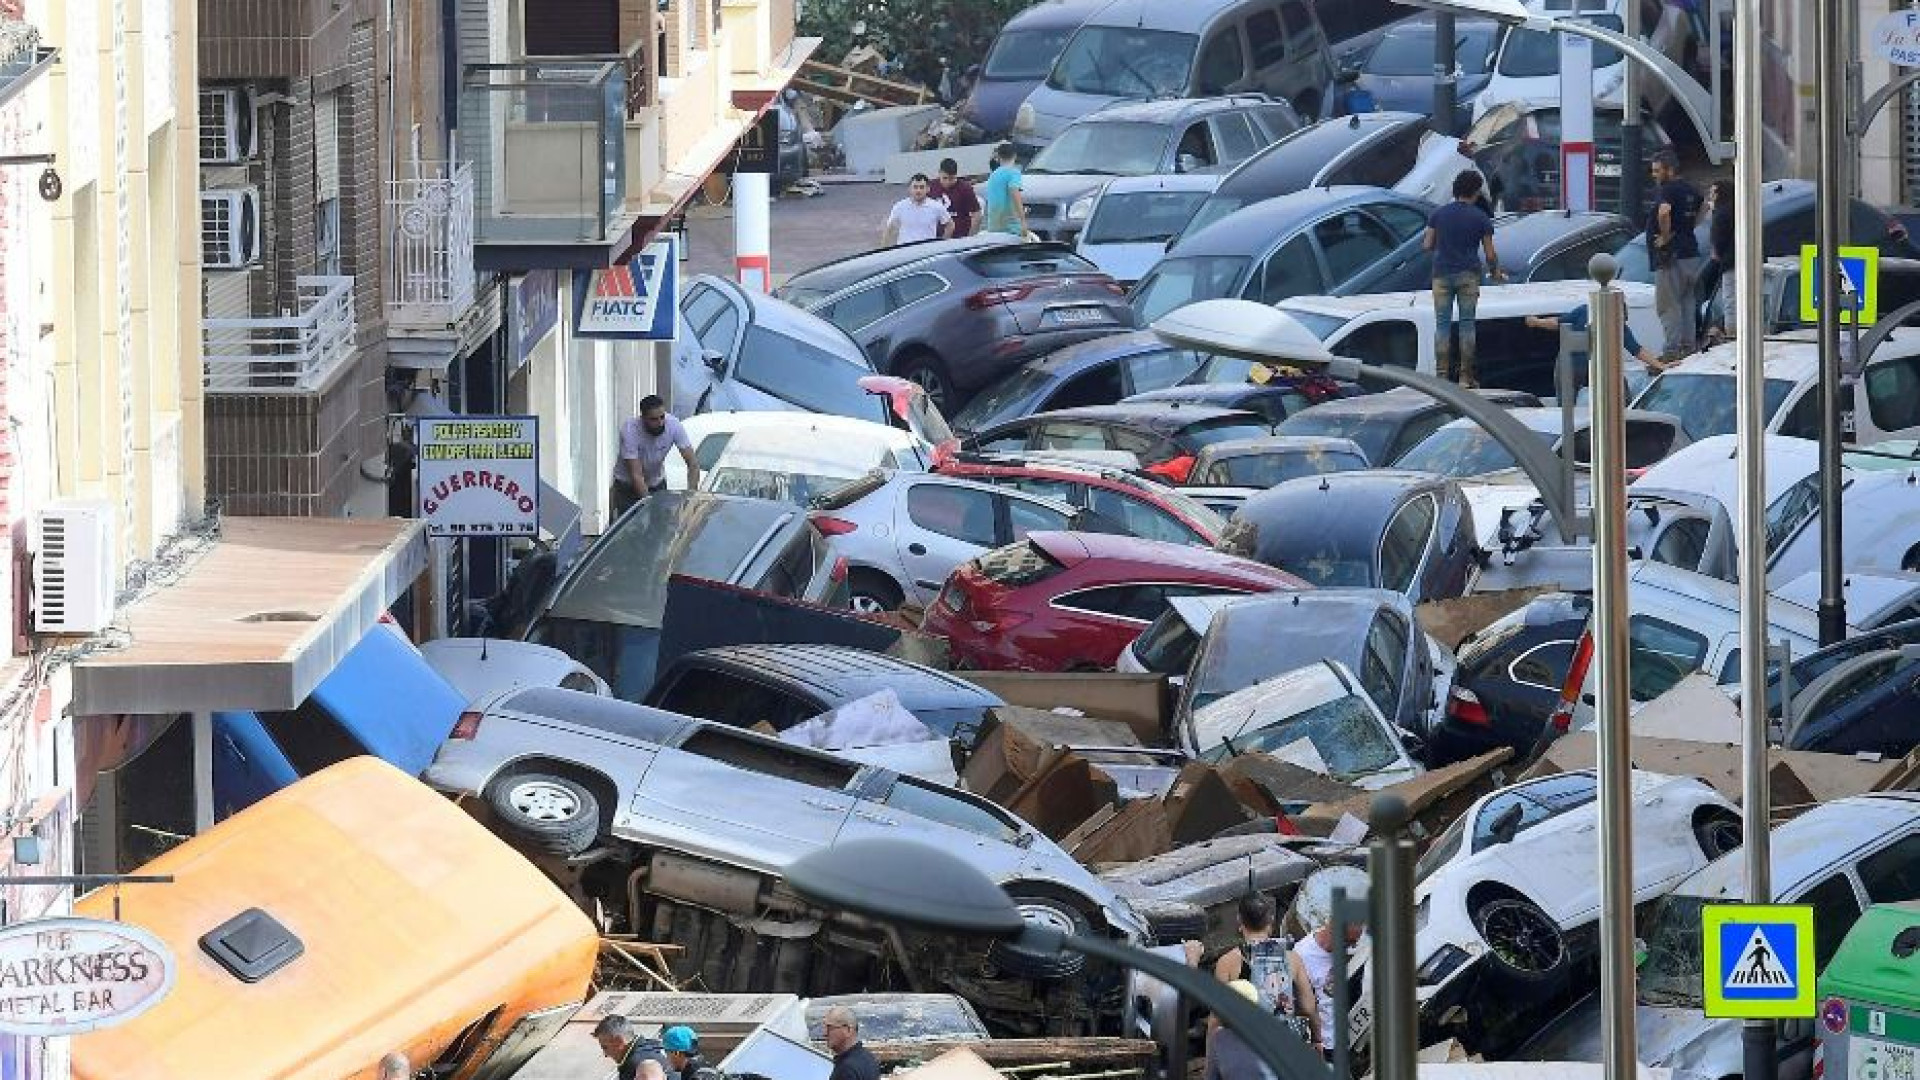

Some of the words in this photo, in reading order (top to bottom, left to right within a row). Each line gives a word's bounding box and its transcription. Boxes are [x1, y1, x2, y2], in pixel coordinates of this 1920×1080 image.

[591, 301, 647, 316] FIATC
[423, 470, 534, 515] GUERRERO
[36, 931, 73, 951] PUB
[0, 951, 149, 988] ARKNESS
[73, 989, 116, 1012] BAR
